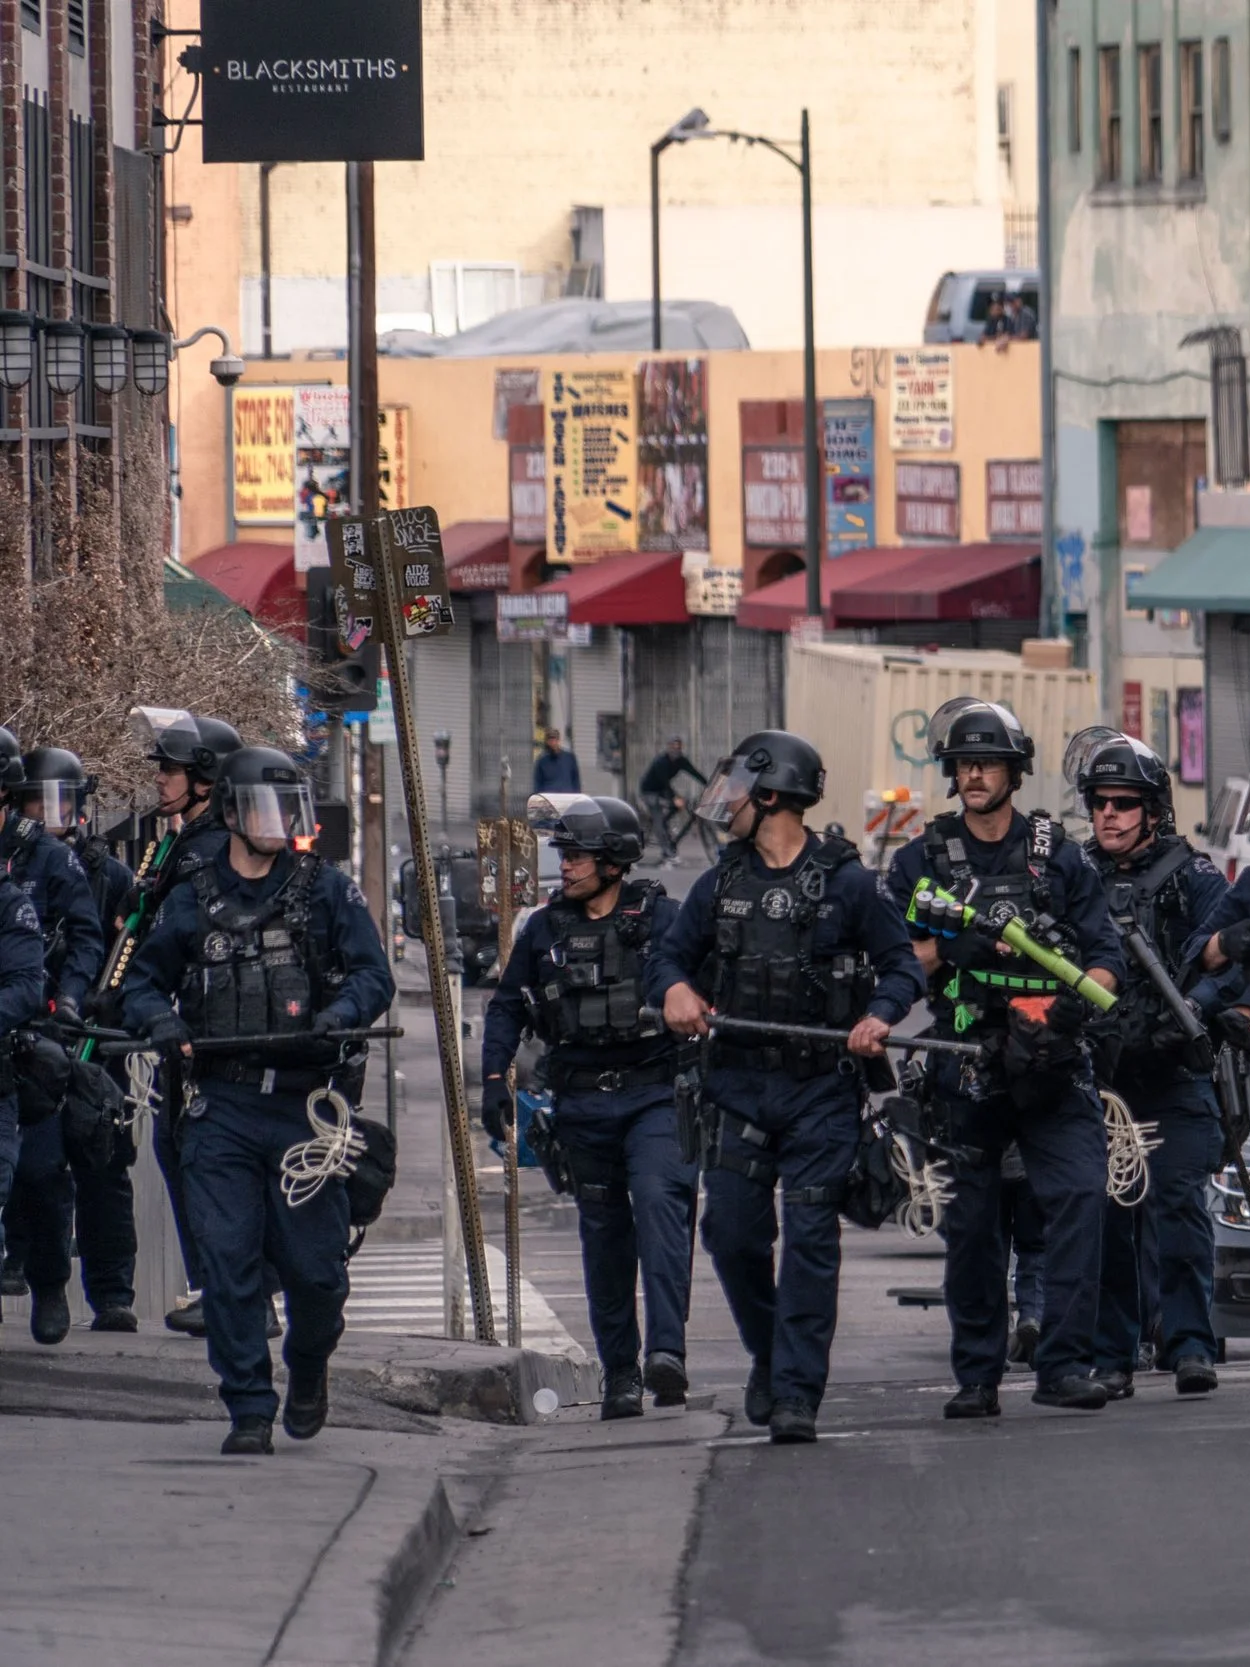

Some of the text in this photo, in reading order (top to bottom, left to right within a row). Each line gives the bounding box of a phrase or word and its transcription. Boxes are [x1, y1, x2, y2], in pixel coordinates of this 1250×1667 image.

[227, 58, 397, 80] BLACKSMITHS
[272, 84, 350, 93] RESTAURANT
[571, 404, 628, 417] WATCHES
[405, 564, 430, 577] AIDZ
[965, 734, 981, 742] NIES
[1033, 816, 1051, 856] POLICE
[723, 905, 748, 915] POLICE
